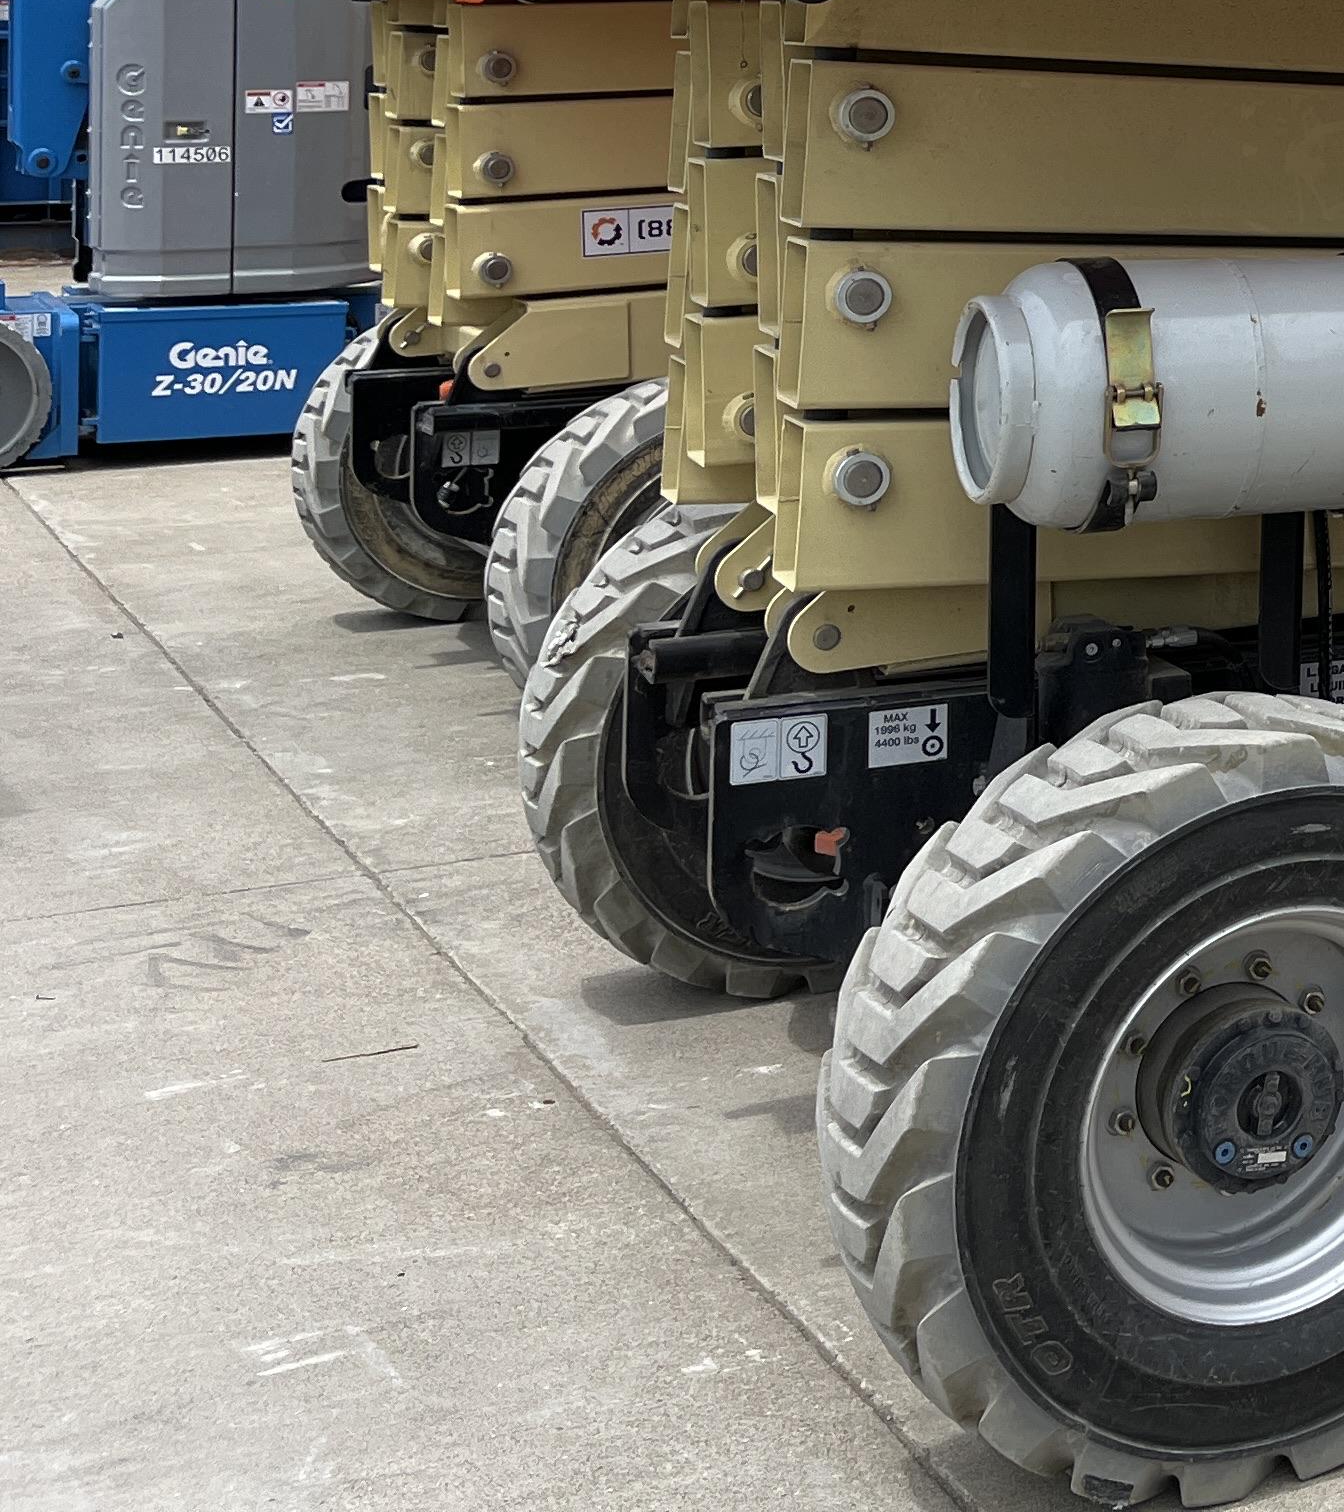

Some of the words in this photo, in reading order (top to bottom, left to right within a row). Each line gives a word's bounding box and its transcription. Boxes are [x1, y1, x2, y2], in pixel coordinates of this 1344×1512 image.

[155, 147, 230, 163] 114506
[169, 340, 269, 369] Genie
[151, 368, 297, 396] Z-30/20N
[883, 712, 909, 723] MAX
[903, 723, 917, 734] kg
[874, 738, 901, 748] 4400
[903, 736, 920, 746] lbs
